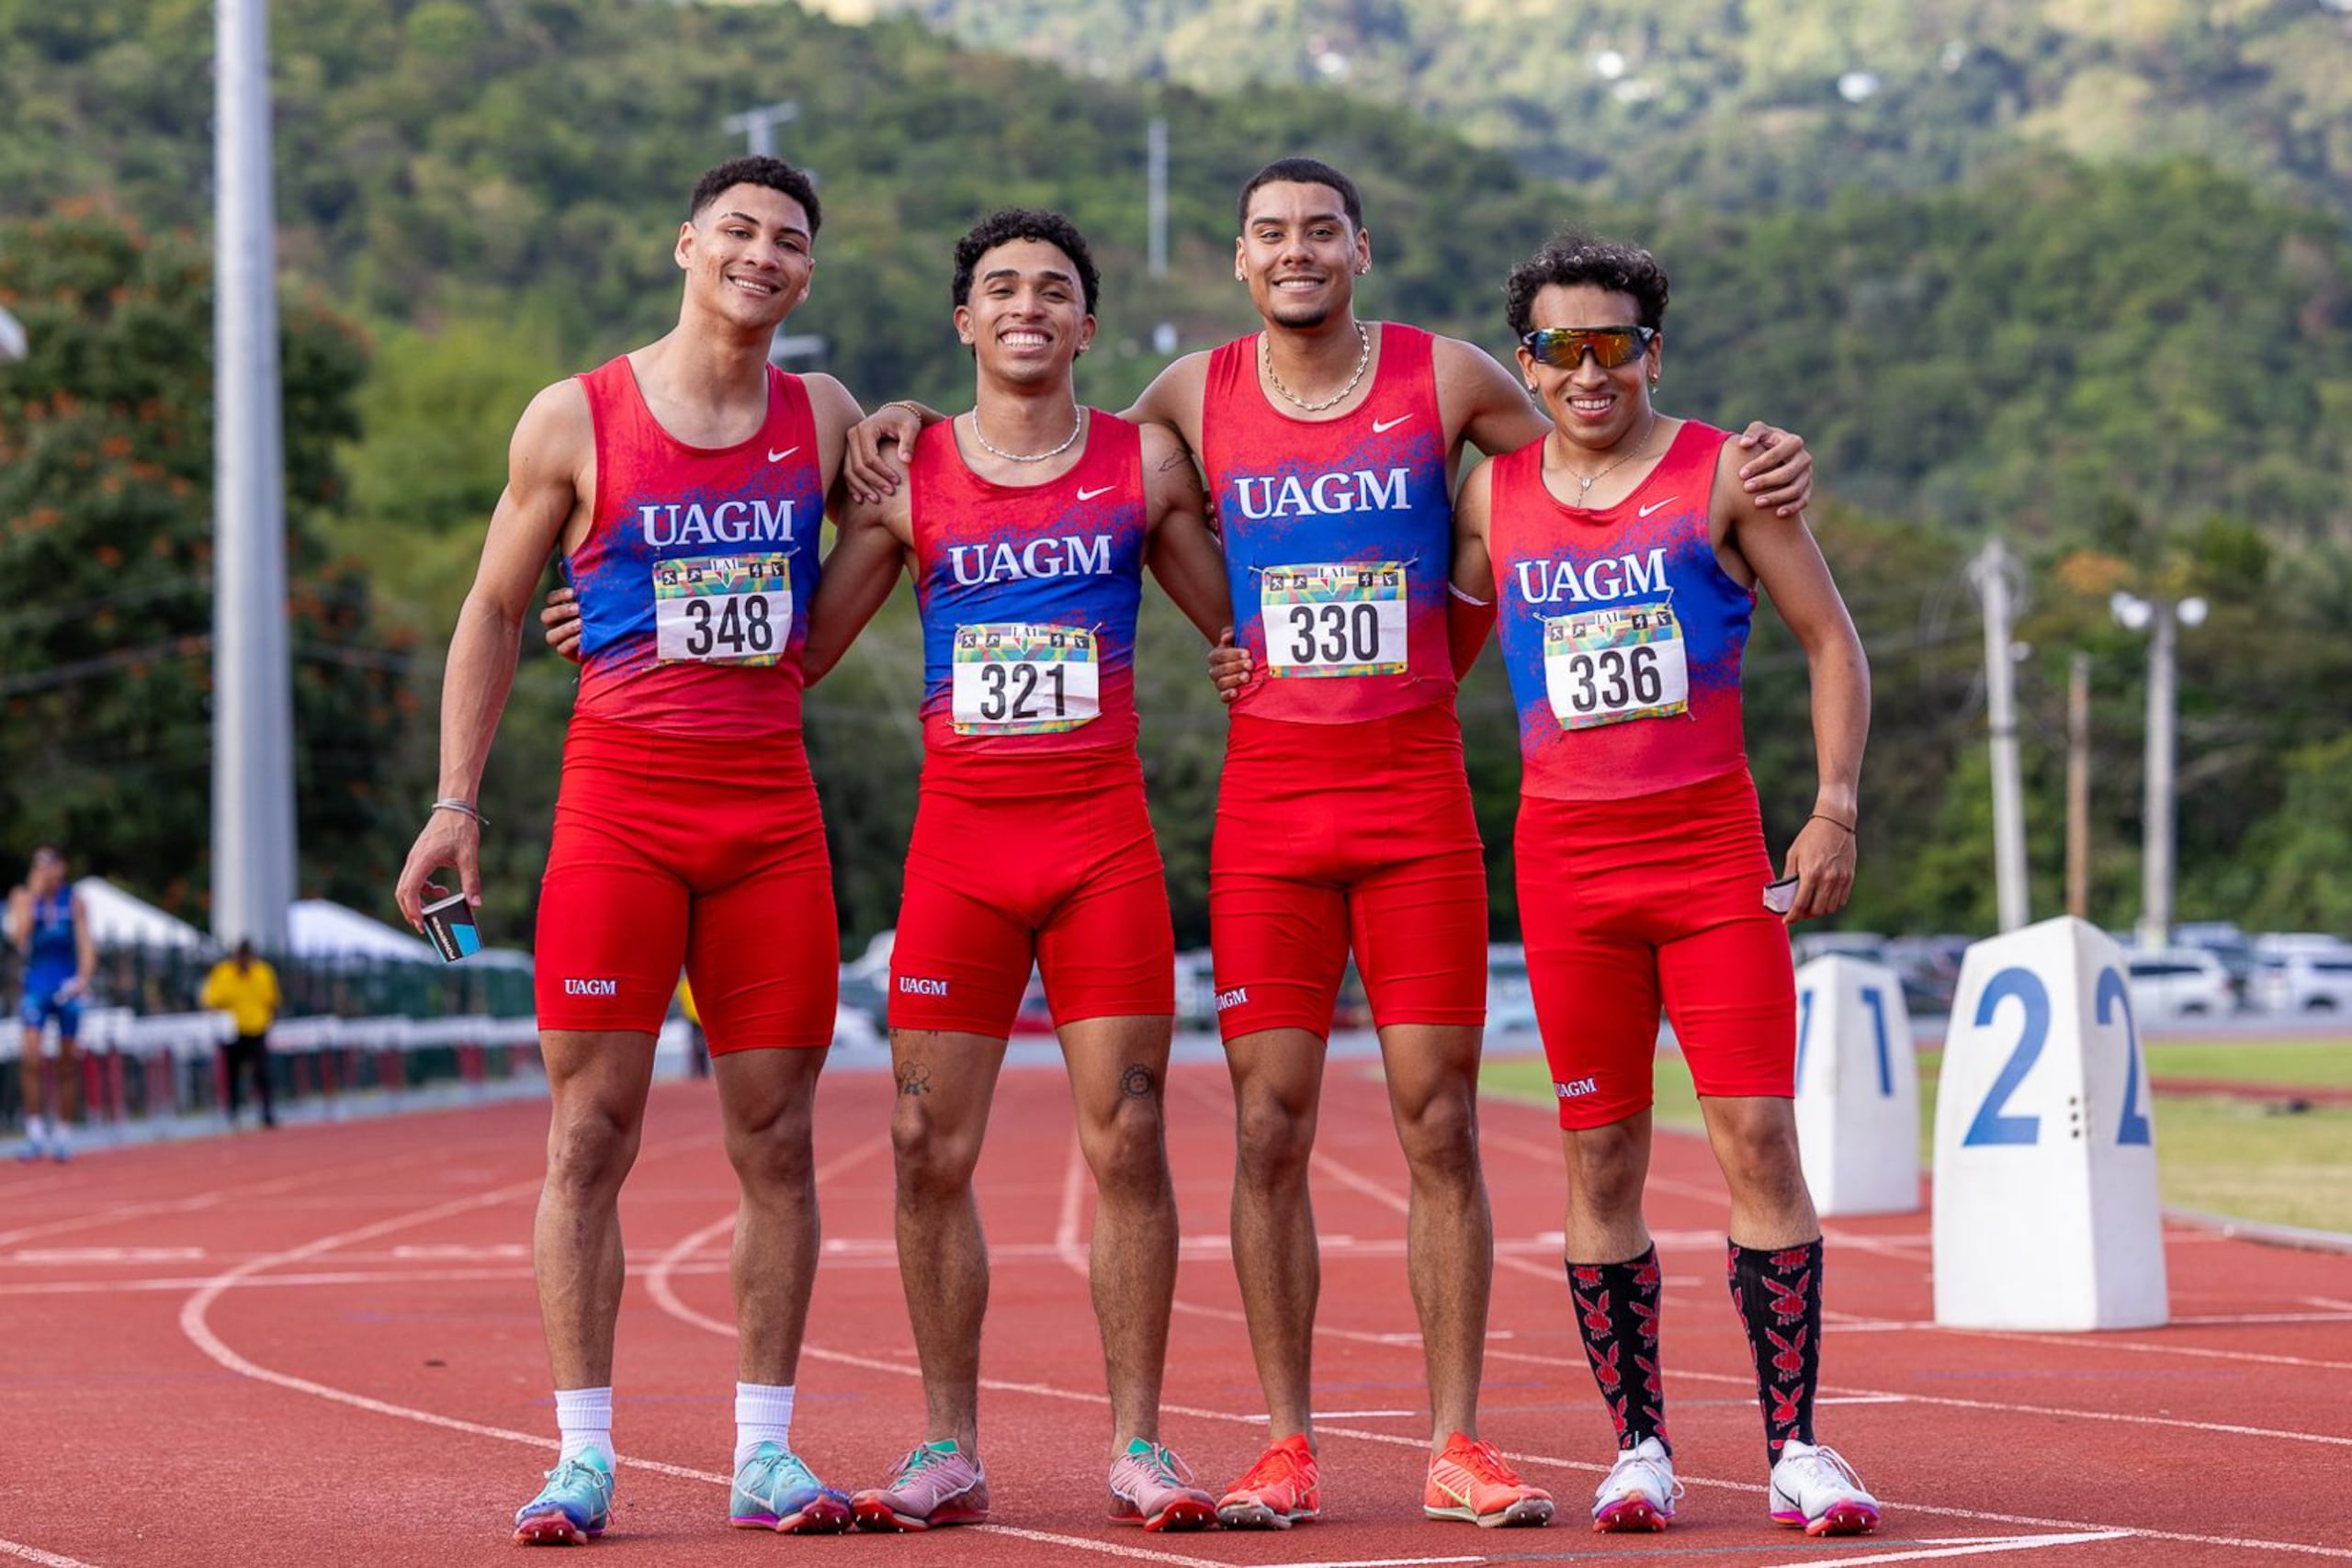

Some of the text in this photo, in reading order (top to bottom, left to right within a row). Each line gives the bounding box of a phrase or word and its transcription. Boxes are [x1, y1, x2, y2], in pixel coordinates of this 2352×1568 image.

[1235, 468, 1412, 520] UAGM
[639, 500, 796, 547] UAGM
[948, 535, 1113, 586] UAGM
[1515, 547, 1672, 604] UAGM
[685, 594, 773, 656] 348
[1290, 604, 1379, 663] 330
[980, 663, 1066, 721] 321
[1569, 646, 1663, 713] 336
[564, 978, 616, 996] UAGM
[899, 976, 948, 996] UAGM
[1859, 987, 1894, 1098] 1
[1962, 966, 2052, 1147] 2
[2095, 966, 2151, 1145] 2
